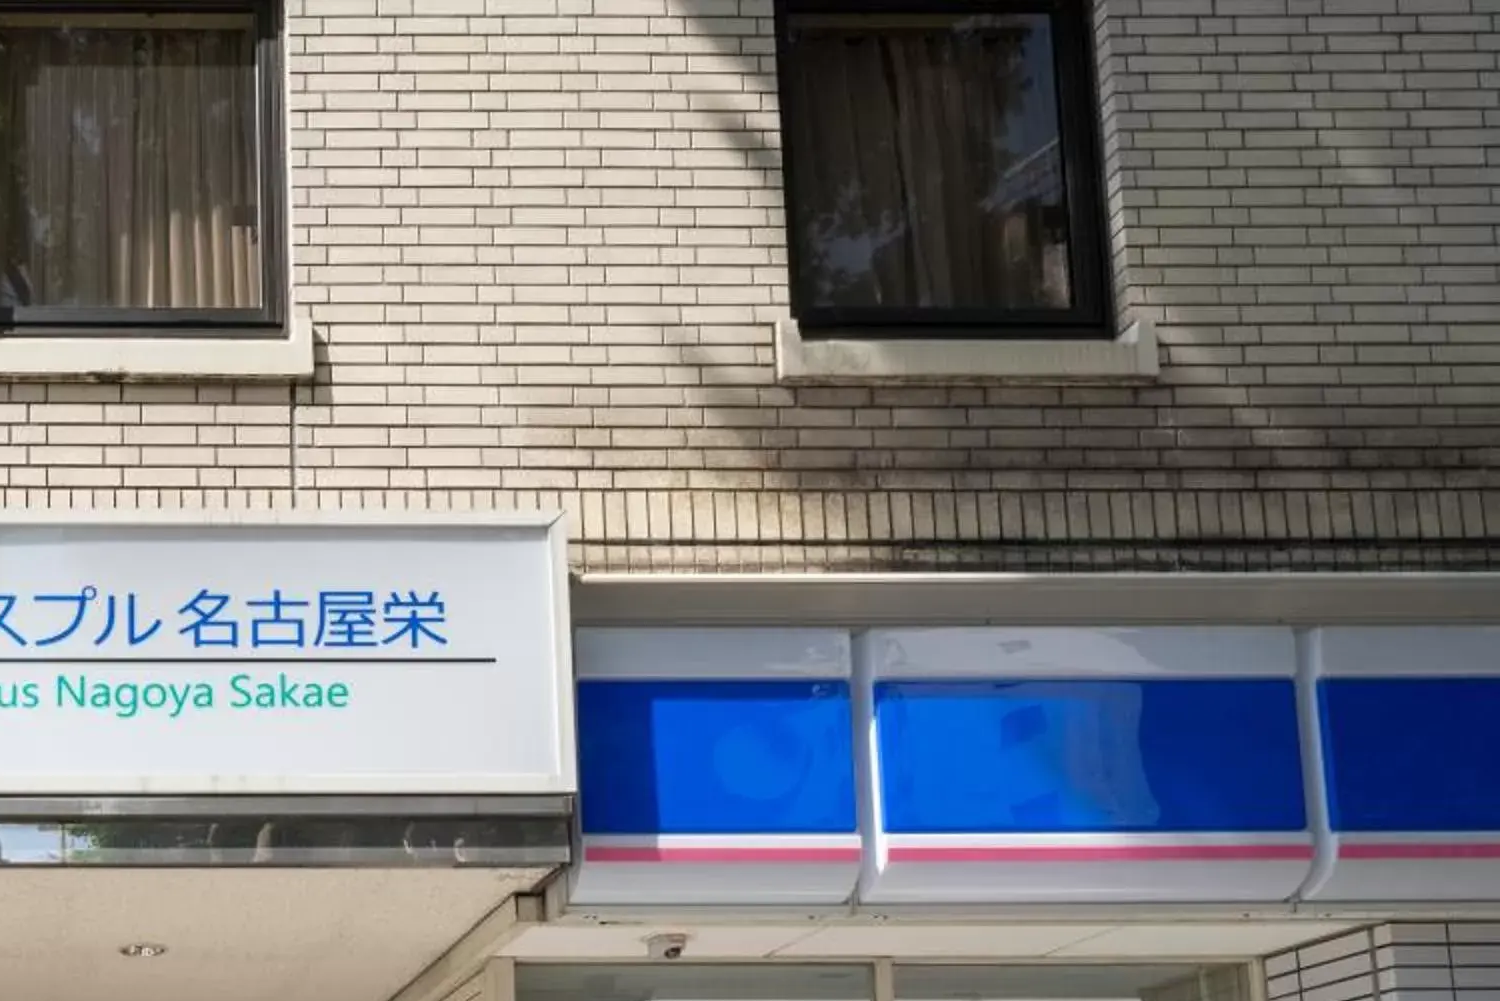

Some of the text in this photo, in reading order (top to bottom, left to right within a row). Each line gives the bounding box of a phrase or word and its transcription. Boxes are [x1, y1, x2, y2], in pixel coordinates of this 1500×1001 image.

[177, 588, 448, 649] 名古屋栄
[55, 674, 215, 718] Nagoya
[229, 672, 349, 708] Sakae
